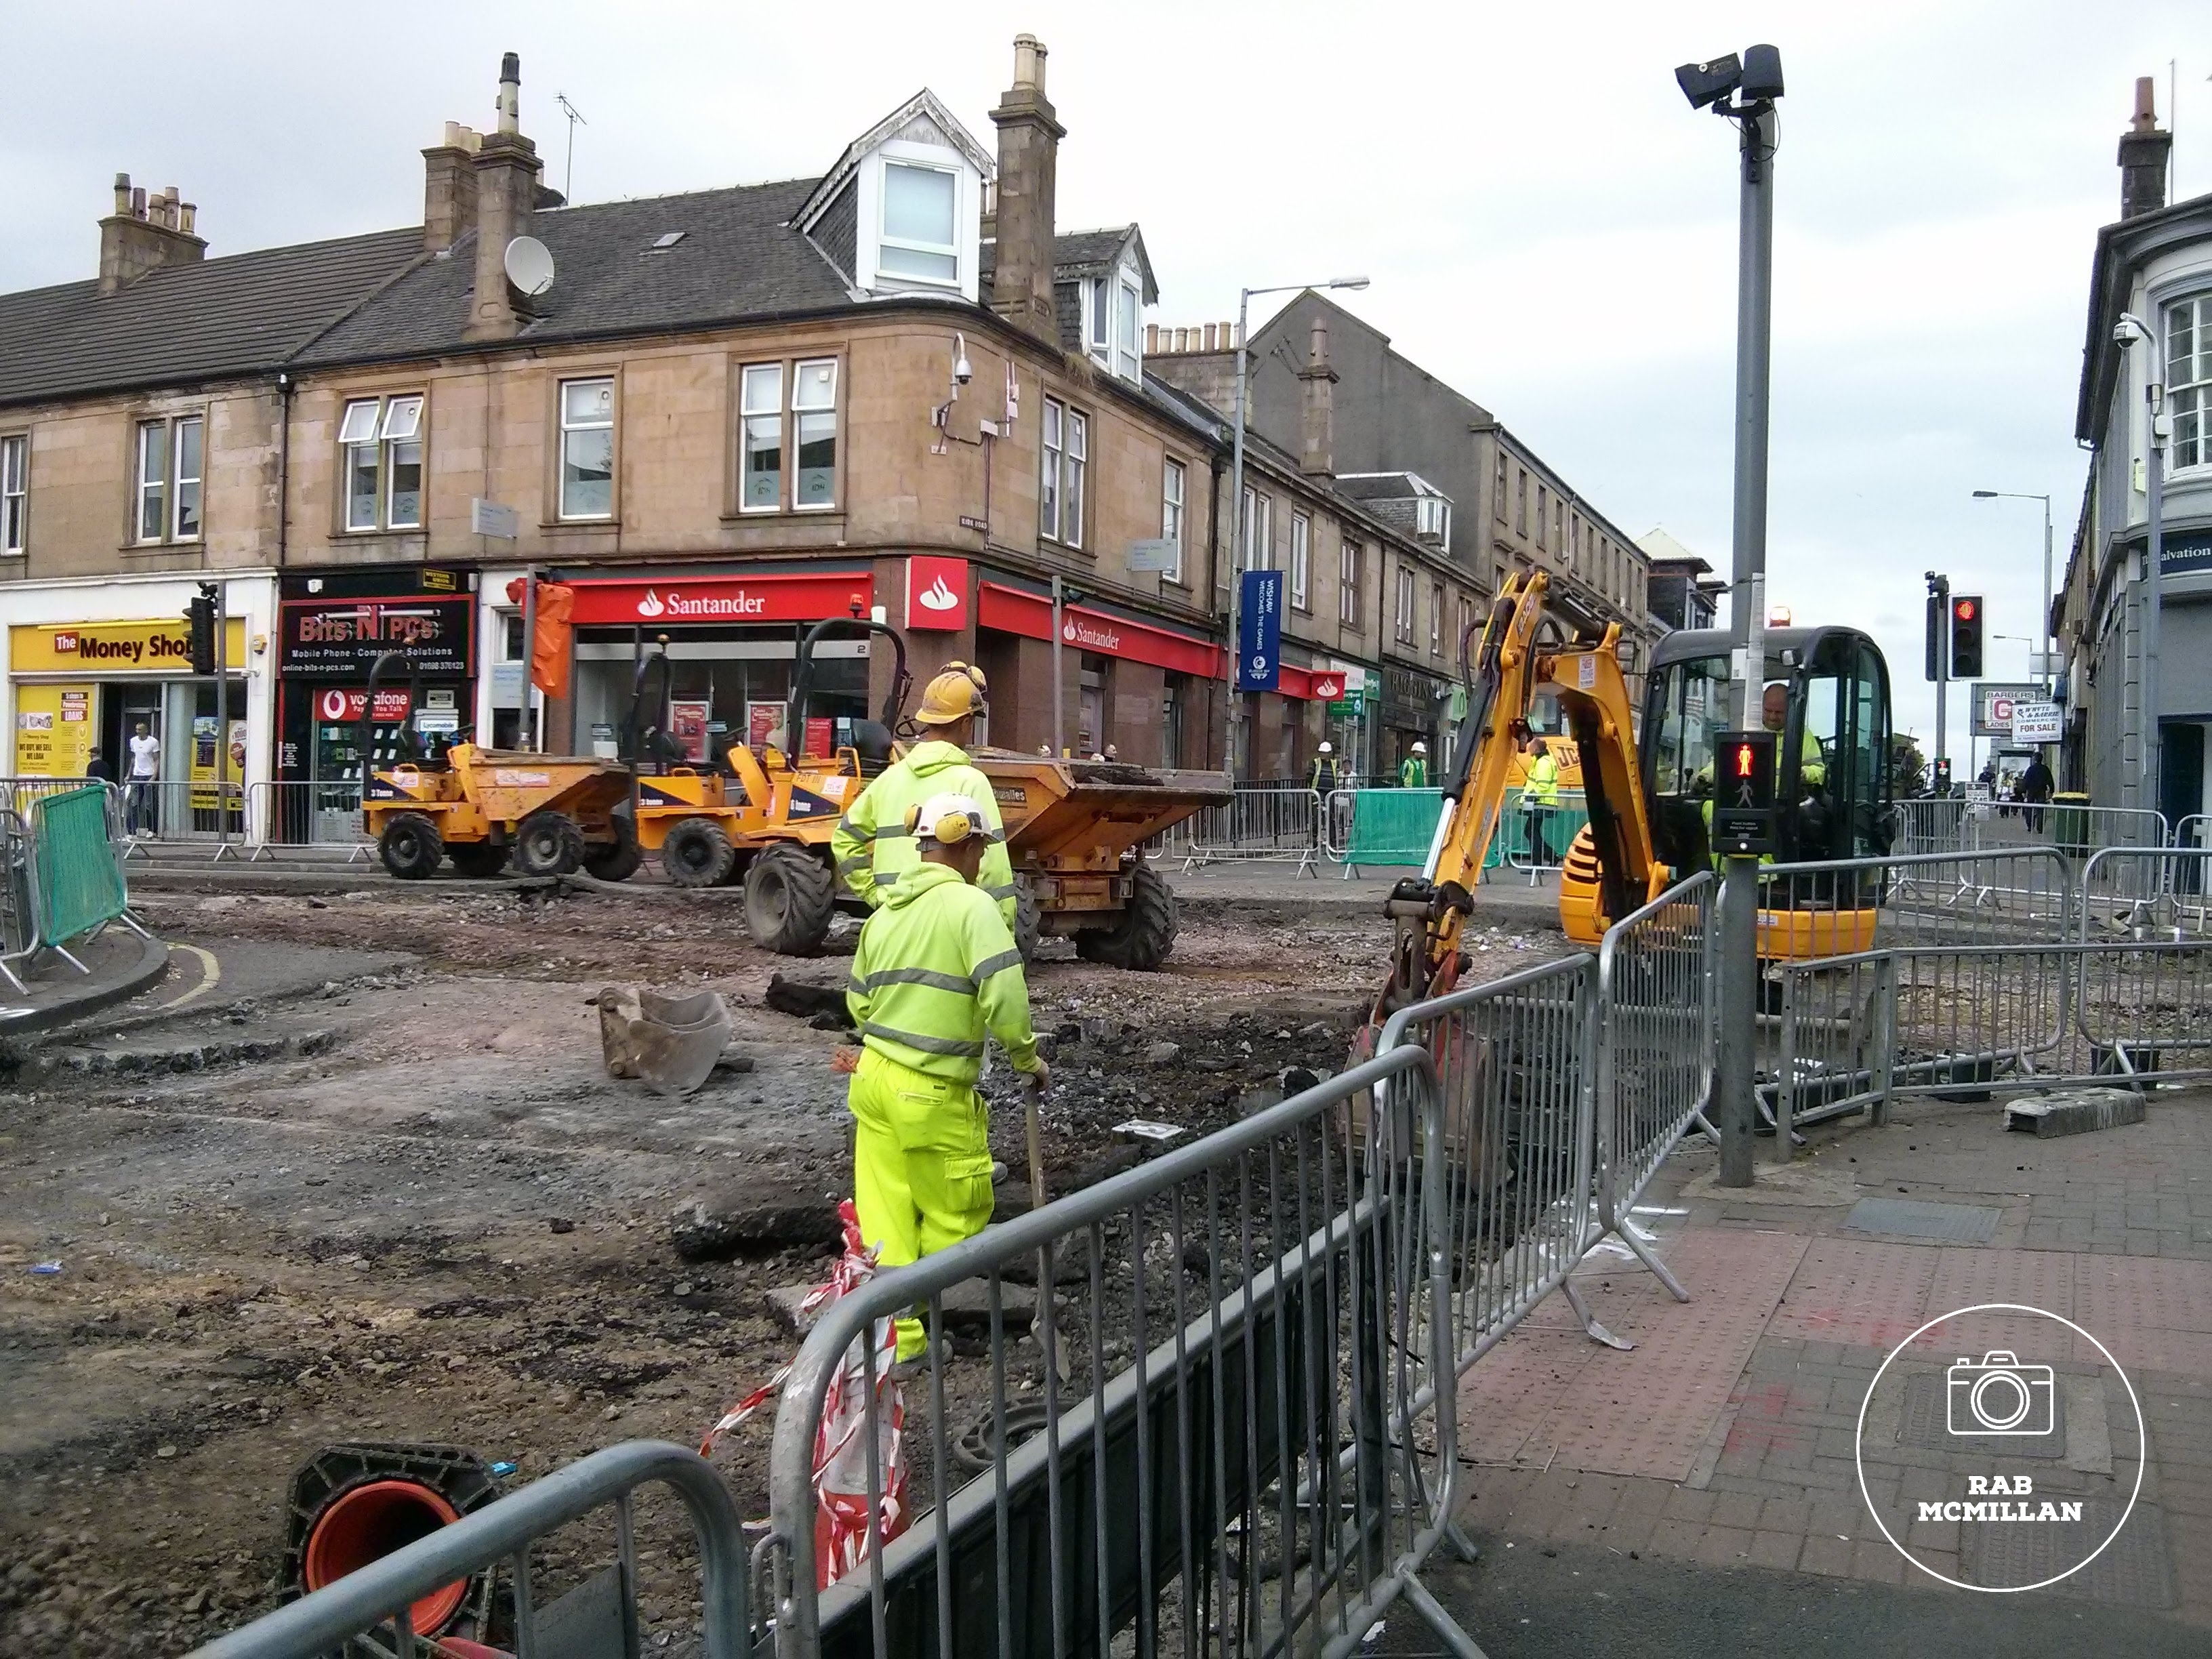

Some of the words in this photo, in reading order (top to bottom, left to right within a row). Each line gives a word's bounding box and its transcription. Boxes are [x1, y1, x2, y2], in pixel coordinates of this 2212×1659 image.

[2160, 546, 2211, 562] alvation
[667, 590, 765, 615] Santander
[1257, 580, 1266, 614] WELCOMES
[1265, 579, 1274, 613] WISHAW
[1077, 621, 1120, 650] Santander
[1256, 628, 1265, 651] GAMES
[56, 636, 76, 649] The
[80, 637, 144, 663] Money
[324, 649, 350, 657] Phone
[407, 647, 452, 656] Solutions
[857, 644, 866, 653] 2
[282, 664, 355, 672] online-bits-n-pcs.com
[350, 691, 407, 705] voafone
[65, 711, 83, 721] LOANS
[353, 705, 365, 714] Pay
[2020, 724, 2035, 733] FOR
[2037, 723, 2057, 732] SALE
[1557, 746, 1579, 767] JC
